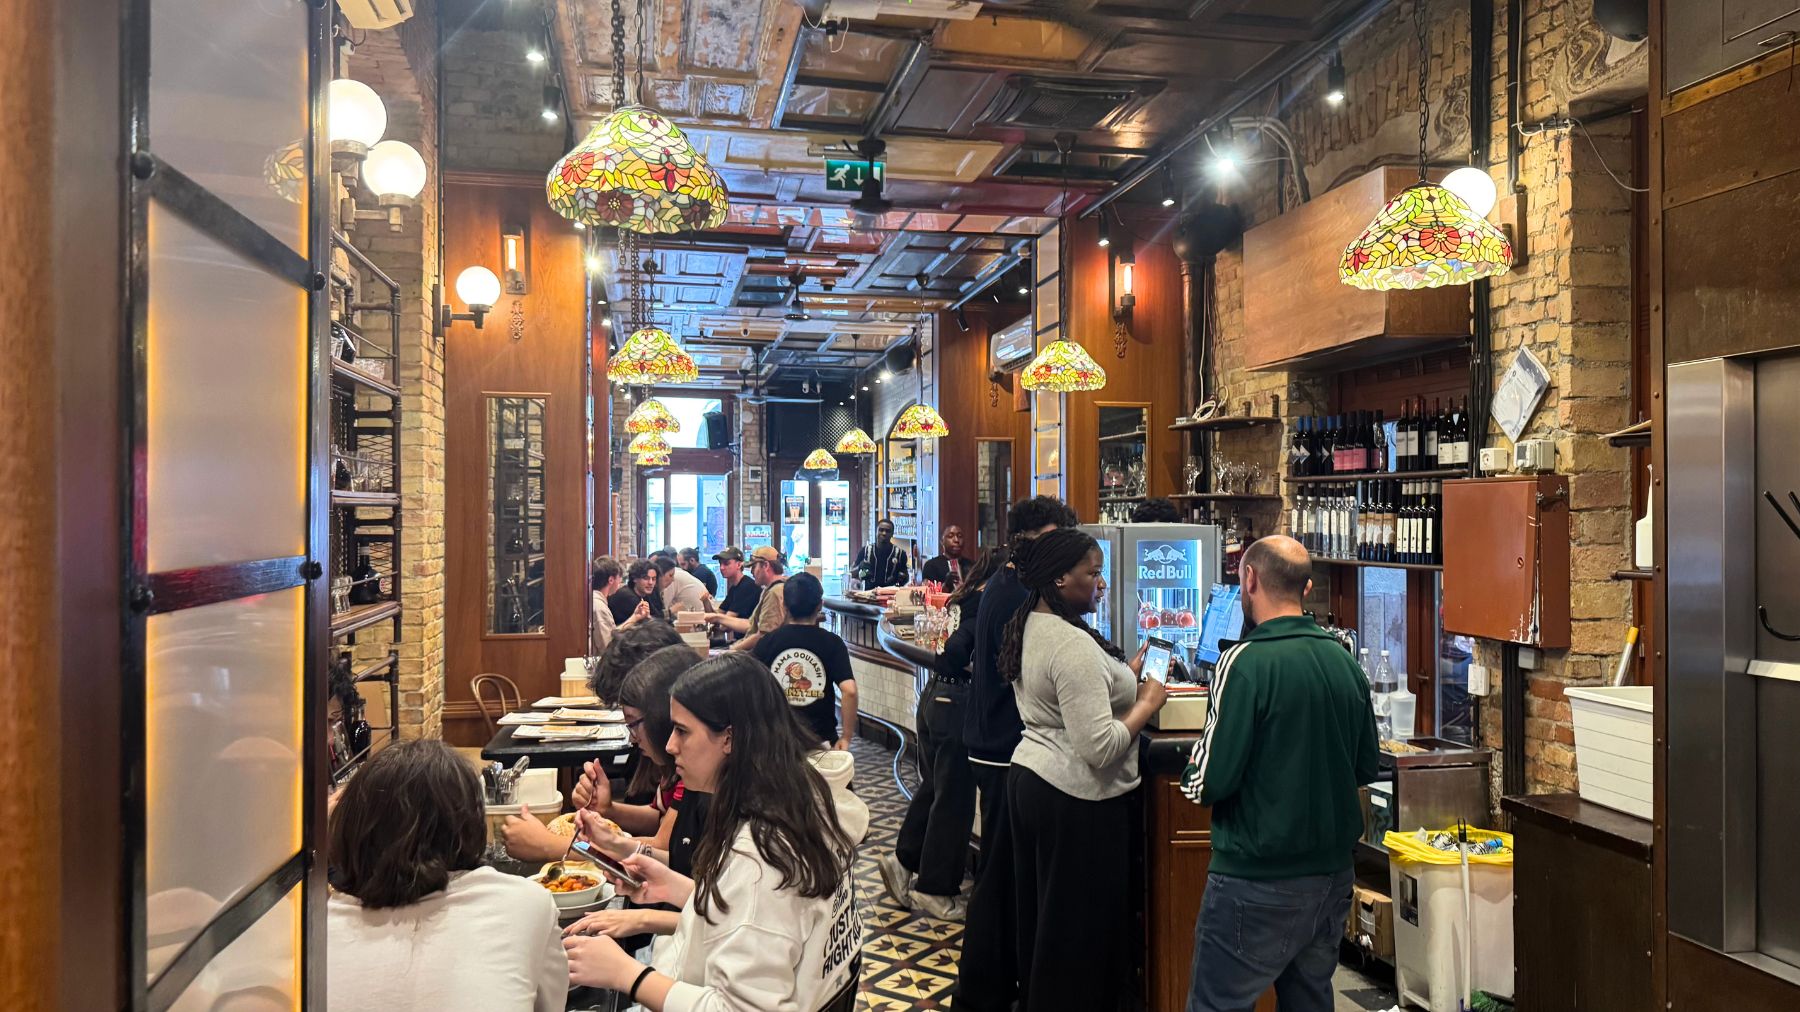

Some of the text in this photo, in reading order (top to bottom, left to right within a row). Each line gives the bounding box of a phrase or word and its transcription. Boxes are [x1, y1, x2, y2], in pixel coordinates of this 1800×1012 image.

[1138, 564, 1192, 580] Red Bull
[774, 654, 792, 673] MAMA
[829, 904, 850, 951] JUST
[822, 927, 853, 979] RIGHT
